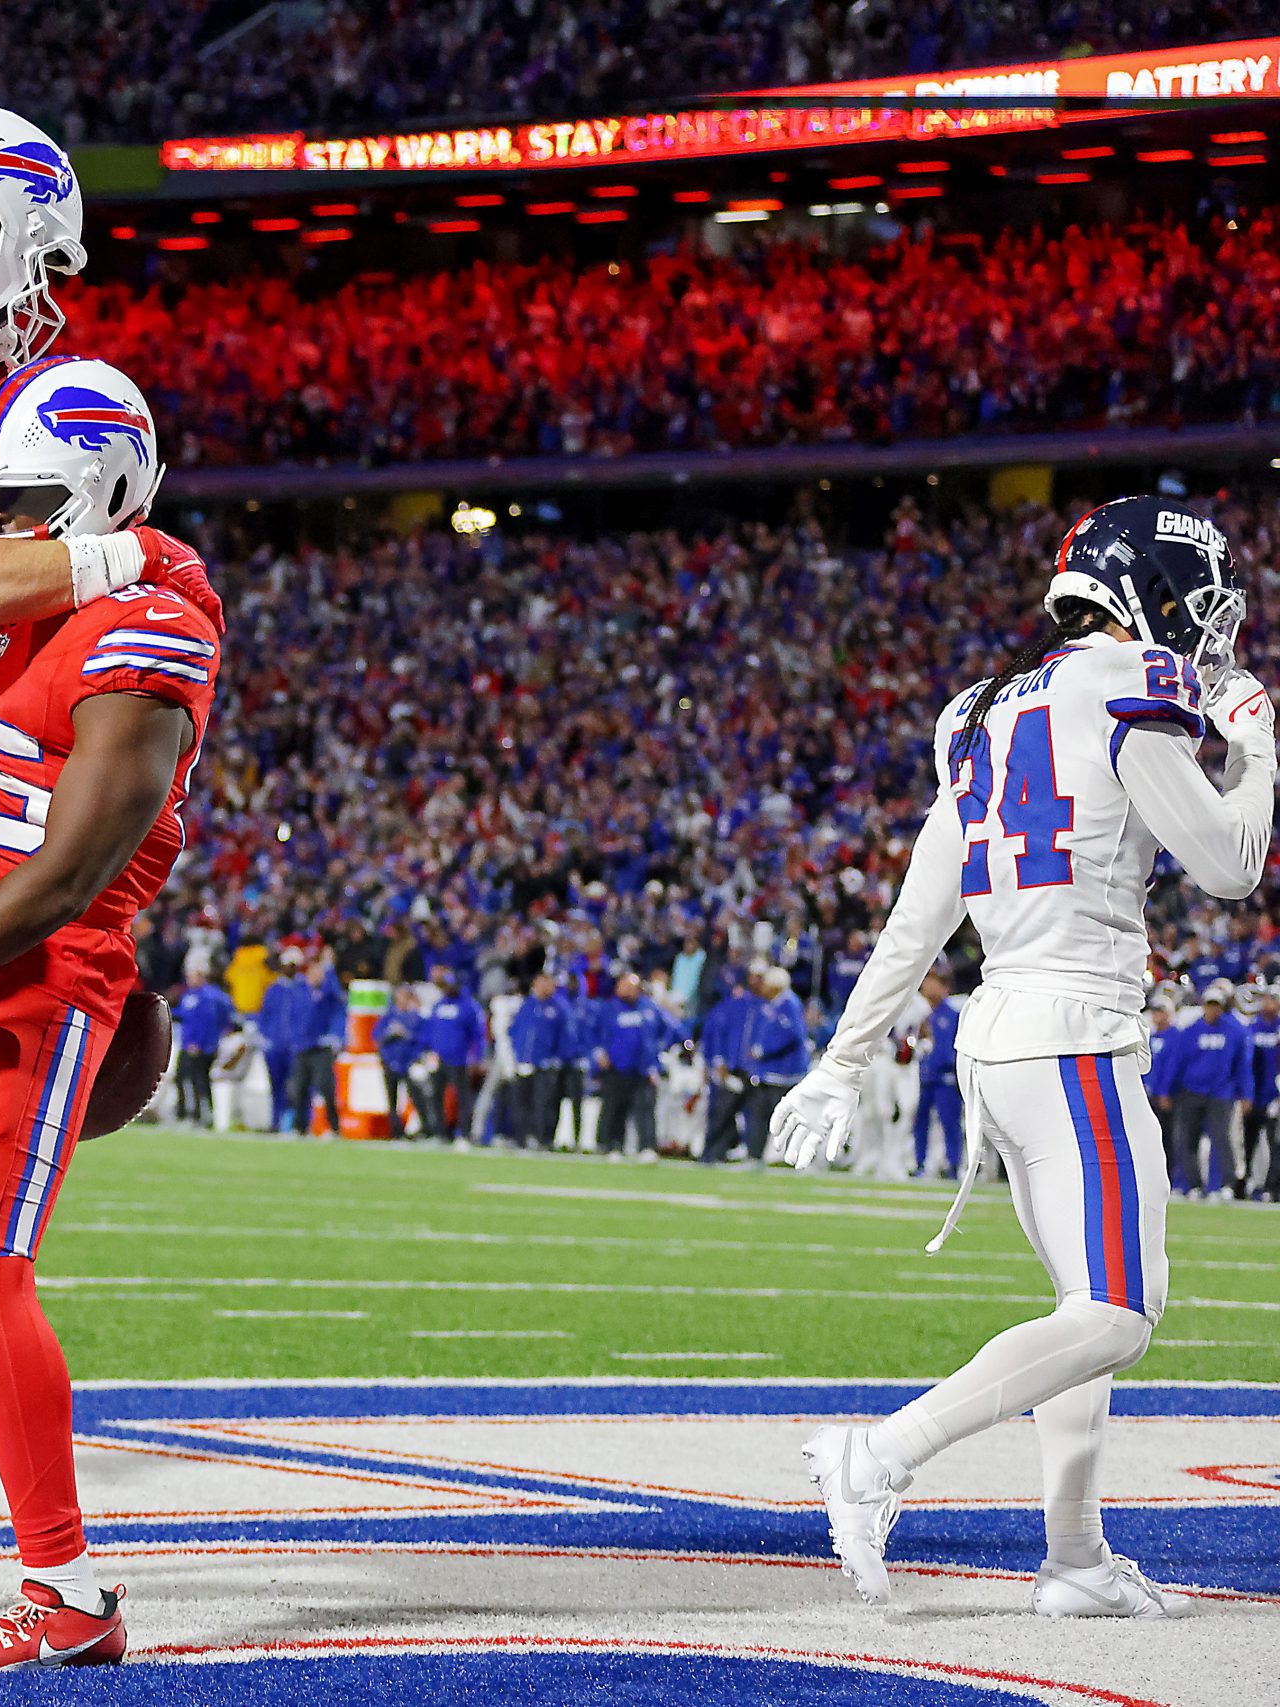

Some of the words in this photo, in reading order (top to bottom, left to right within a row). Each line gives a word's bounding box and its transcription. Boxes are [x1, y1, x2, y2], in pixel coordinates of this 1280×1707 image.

[1106, 56, 1271, 98] BATTERY
[304, 141, 390, 169] STAY
[528, 119, 620, 162] STAY
[1142, 649, 1202, 710] 24
[948, 704, 1075, 898] 24
